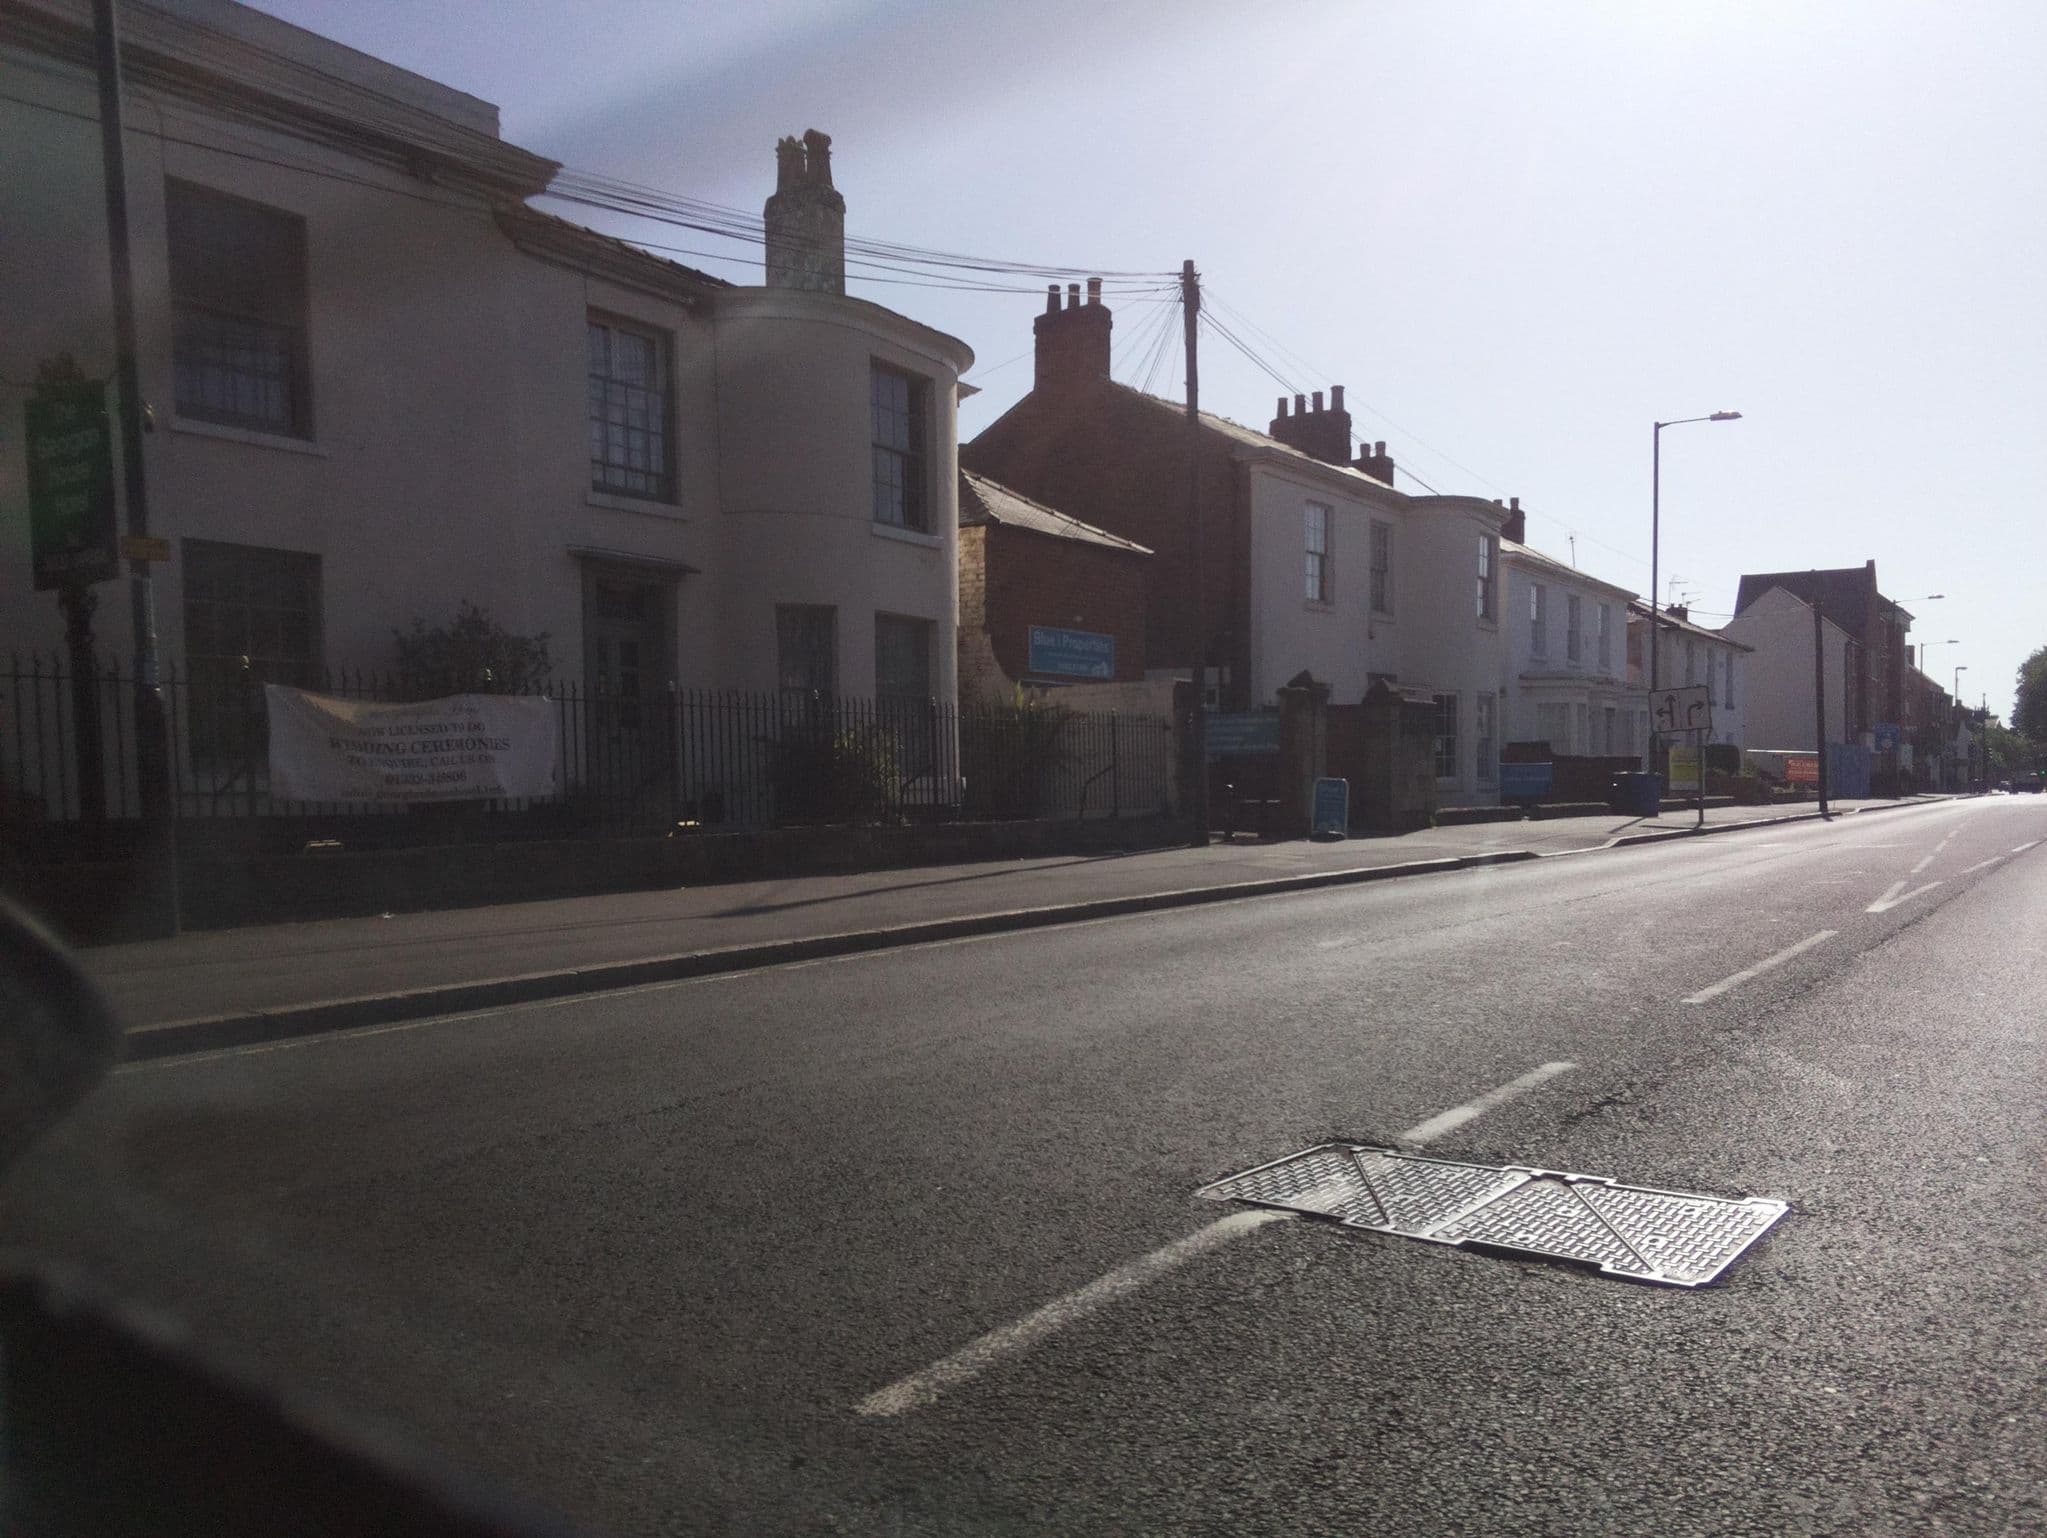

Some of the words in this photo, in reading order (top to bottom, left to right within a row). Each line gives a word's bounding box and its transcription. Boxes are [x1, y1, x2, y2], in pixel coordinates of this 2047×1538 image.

[1033, 630, 1055, 647] Blue
[388, 723, 449, 737] LICENSED
[467, 721, 486, 732] DO
[329, 736, 407, 755] WEDDING
[410, 737, 512, 755] CEREMONIES
[430, 755, 459, 767] CALL
